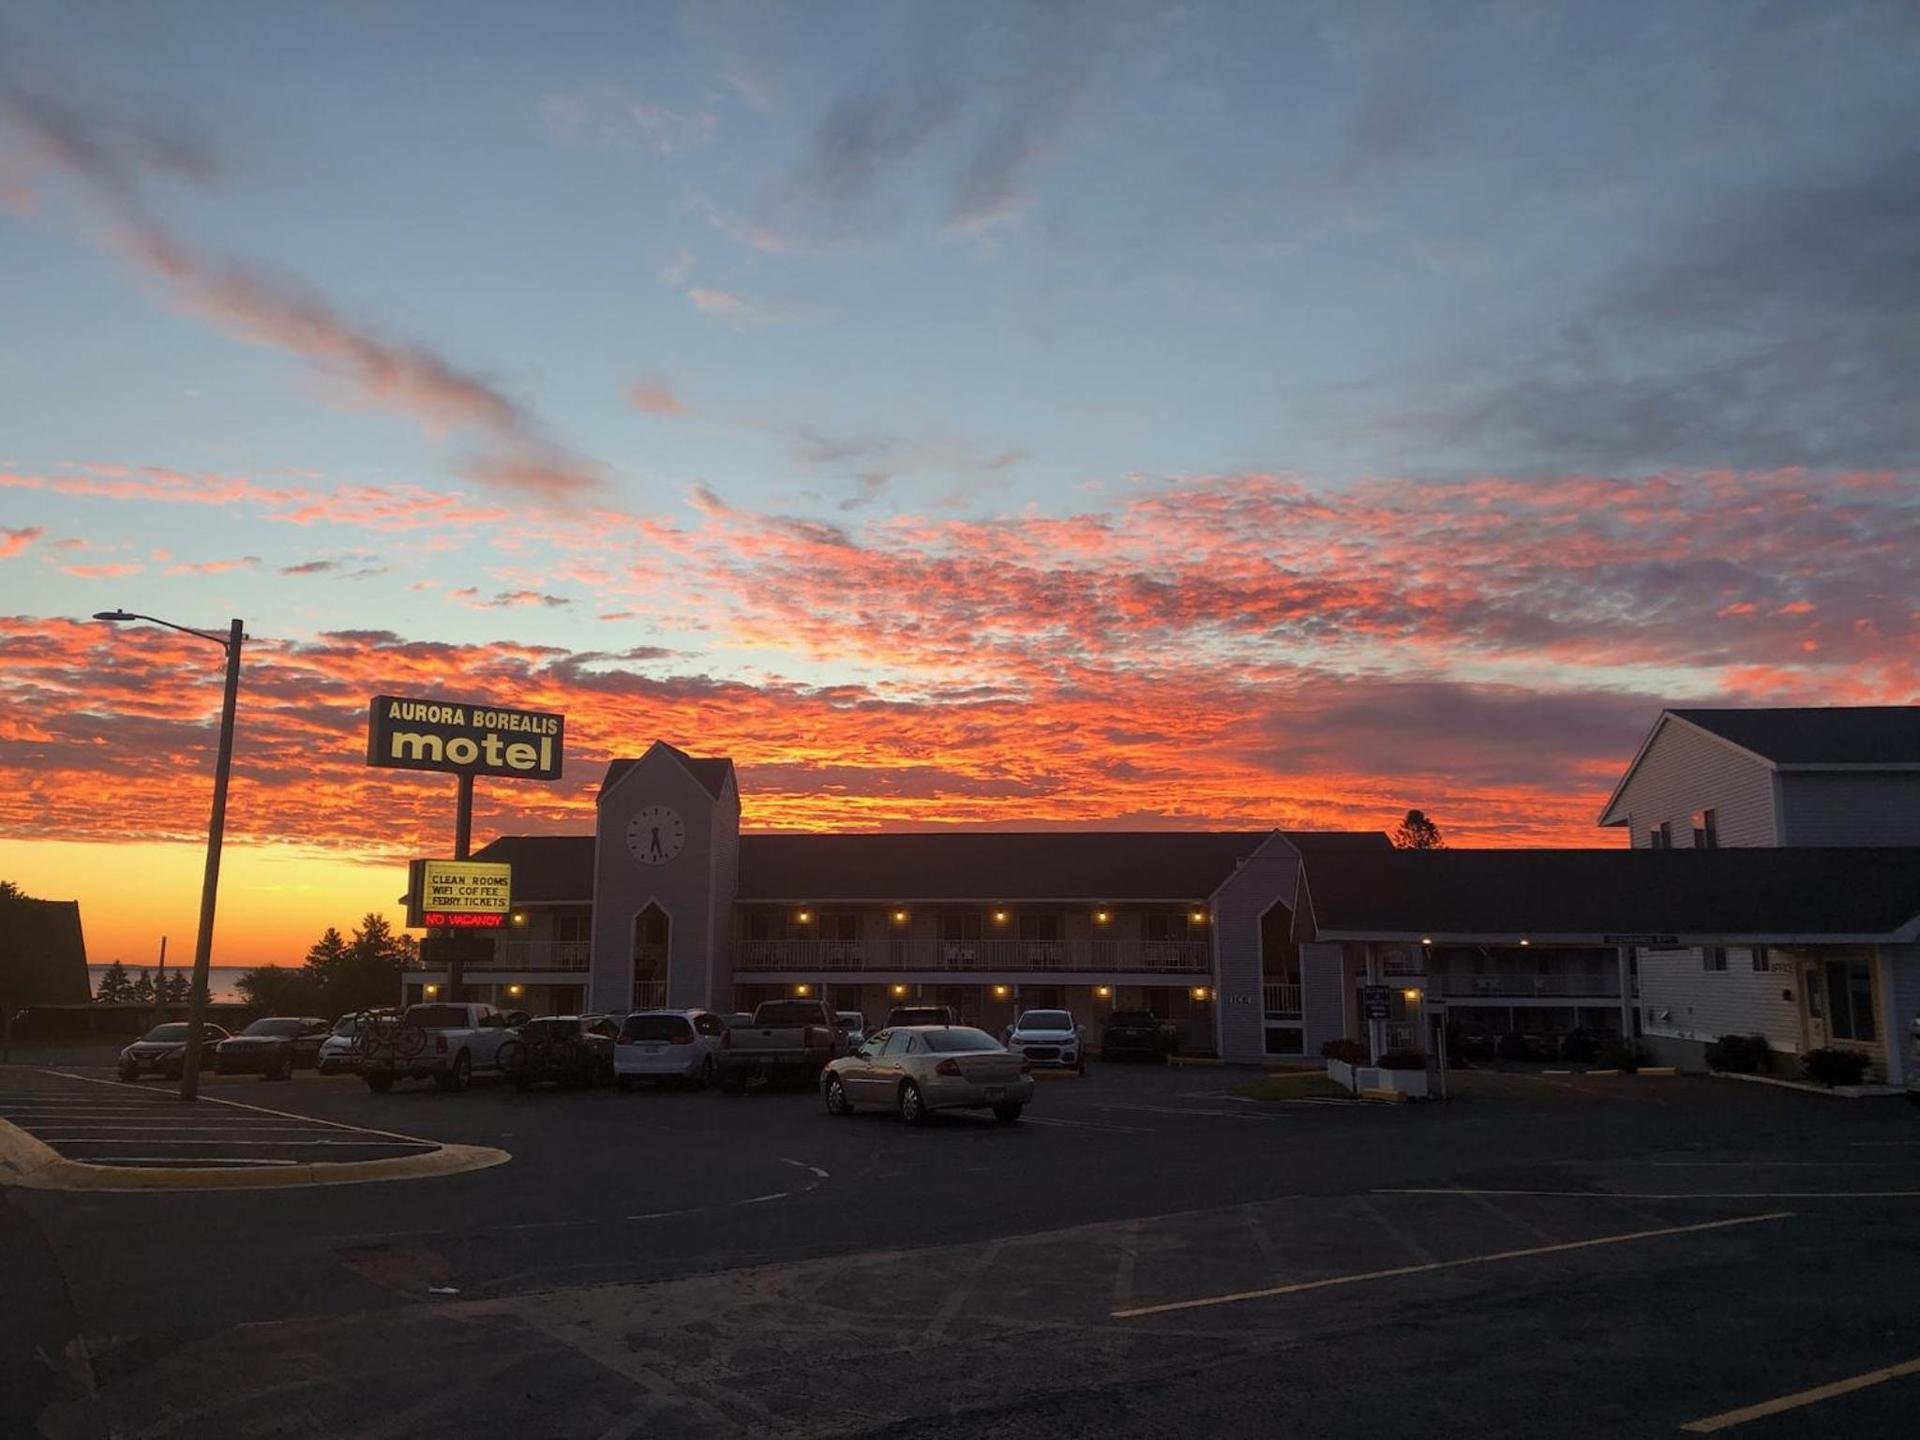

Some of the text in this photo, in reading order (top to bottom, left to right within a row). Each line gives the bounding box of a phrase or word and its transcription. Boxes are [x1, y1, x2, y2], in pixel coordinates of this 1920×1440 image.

[388, 702, 558, 736] AURORA BOREALIS
[391, 731, 553, 772] motel
[431, 875, 508, 886] CLEAN ROOMS
[431, 886, 453, 895] WIFI
[431, 896, 506, 907] FERRY TICKETS
[426, 914, 503, 927] NO VACANCY
